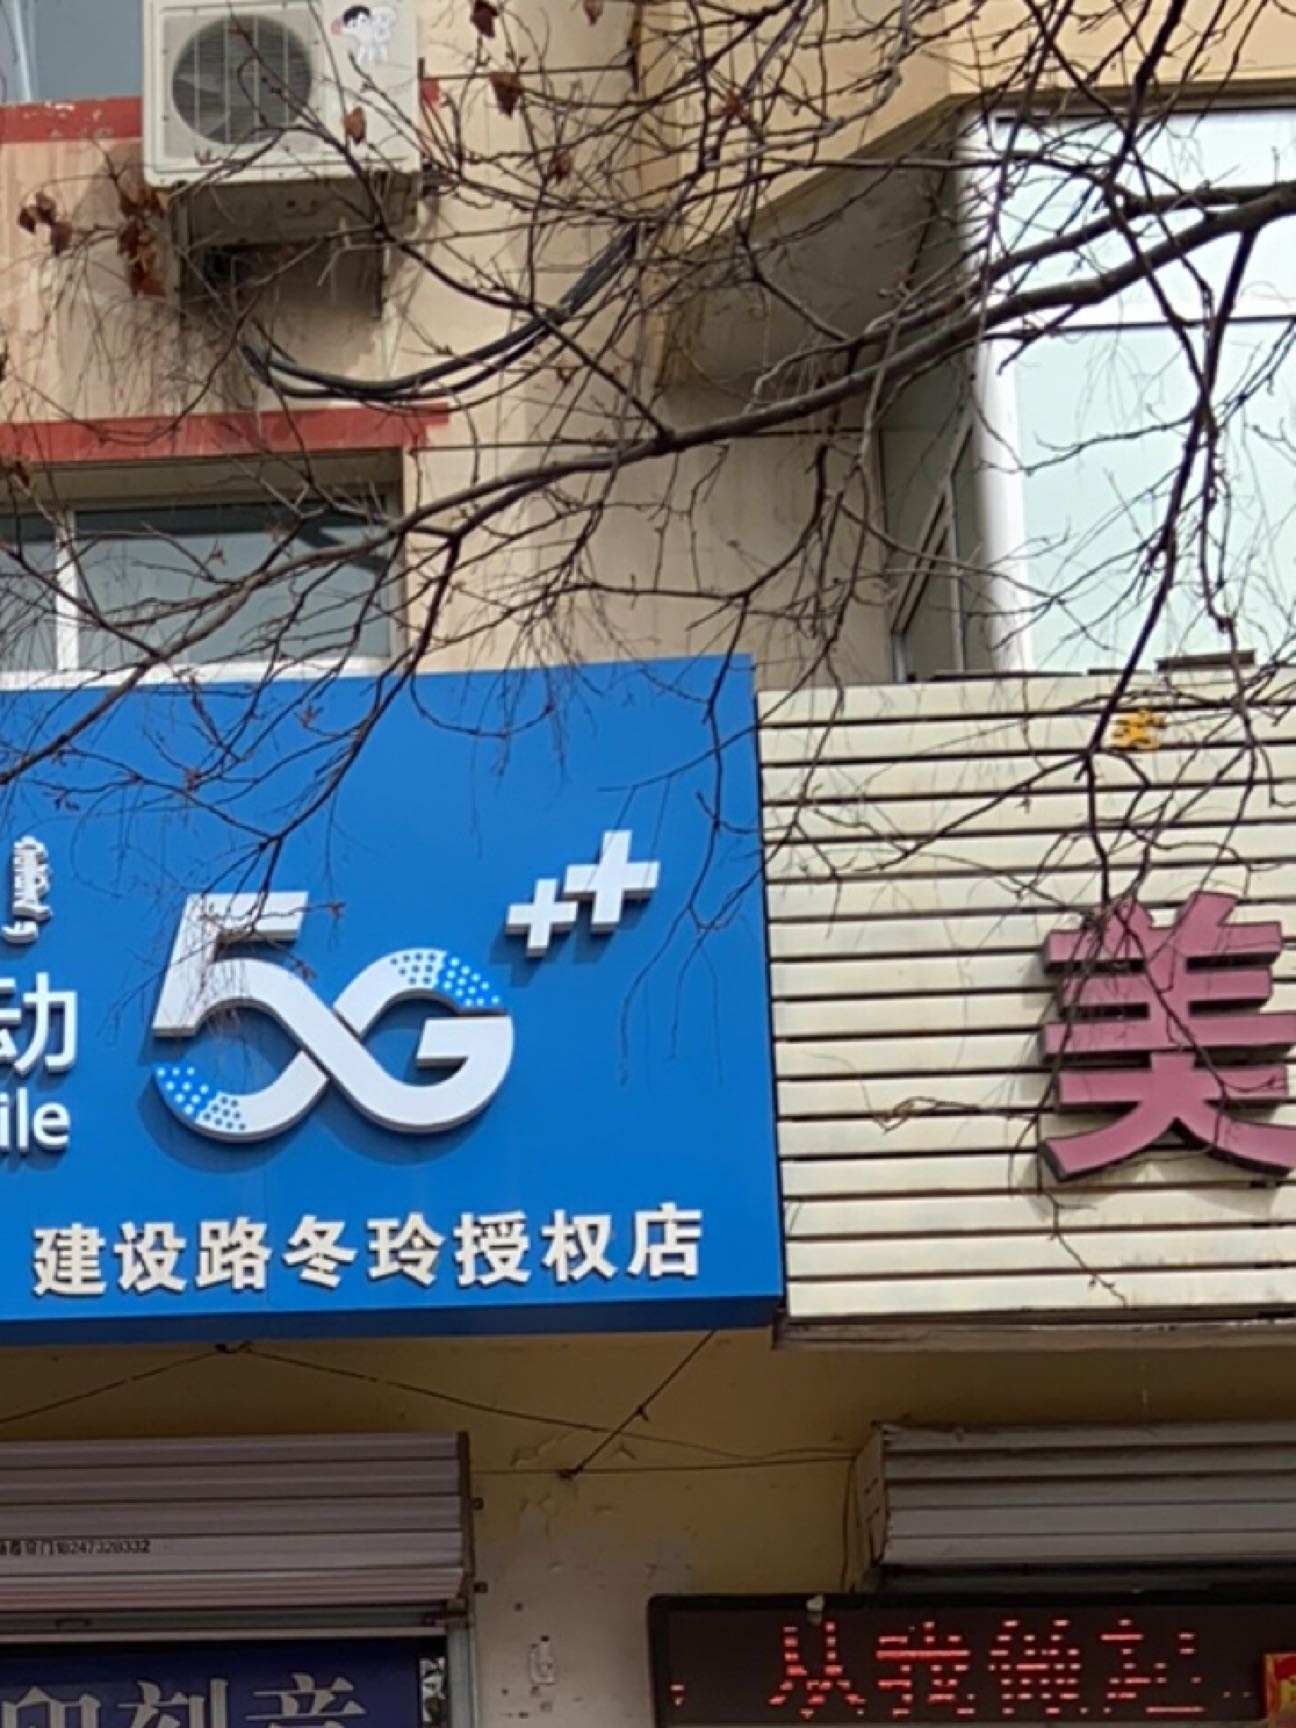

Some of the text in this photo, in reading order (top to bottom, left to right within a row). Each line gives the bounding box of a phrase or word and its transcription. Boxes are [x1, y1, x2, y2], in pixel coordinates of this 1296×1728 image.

[1040, 890, 1296, 1182] 美
[32, 1202, 706, 1300] 建设路冬玲授权店
